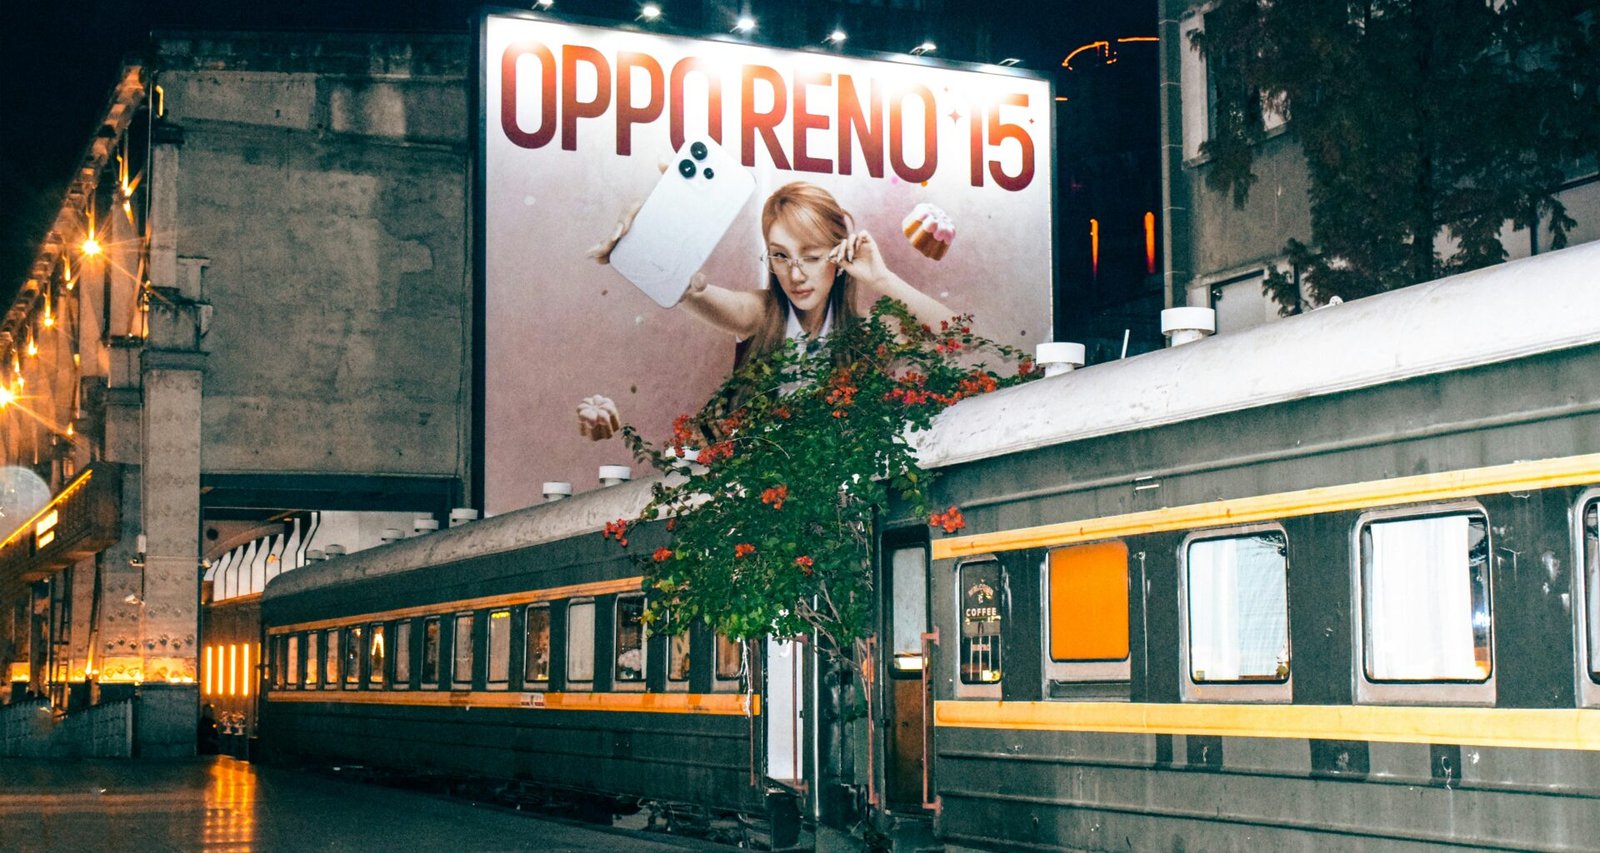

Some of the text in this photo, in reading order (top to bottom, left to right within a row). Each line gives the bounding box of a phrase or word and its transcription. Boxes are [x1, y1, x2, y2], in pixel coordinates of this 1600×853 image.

[501, 41, 1035, 191] OPPO RENO 15
[966, 607, 997, 617] COFFEE
